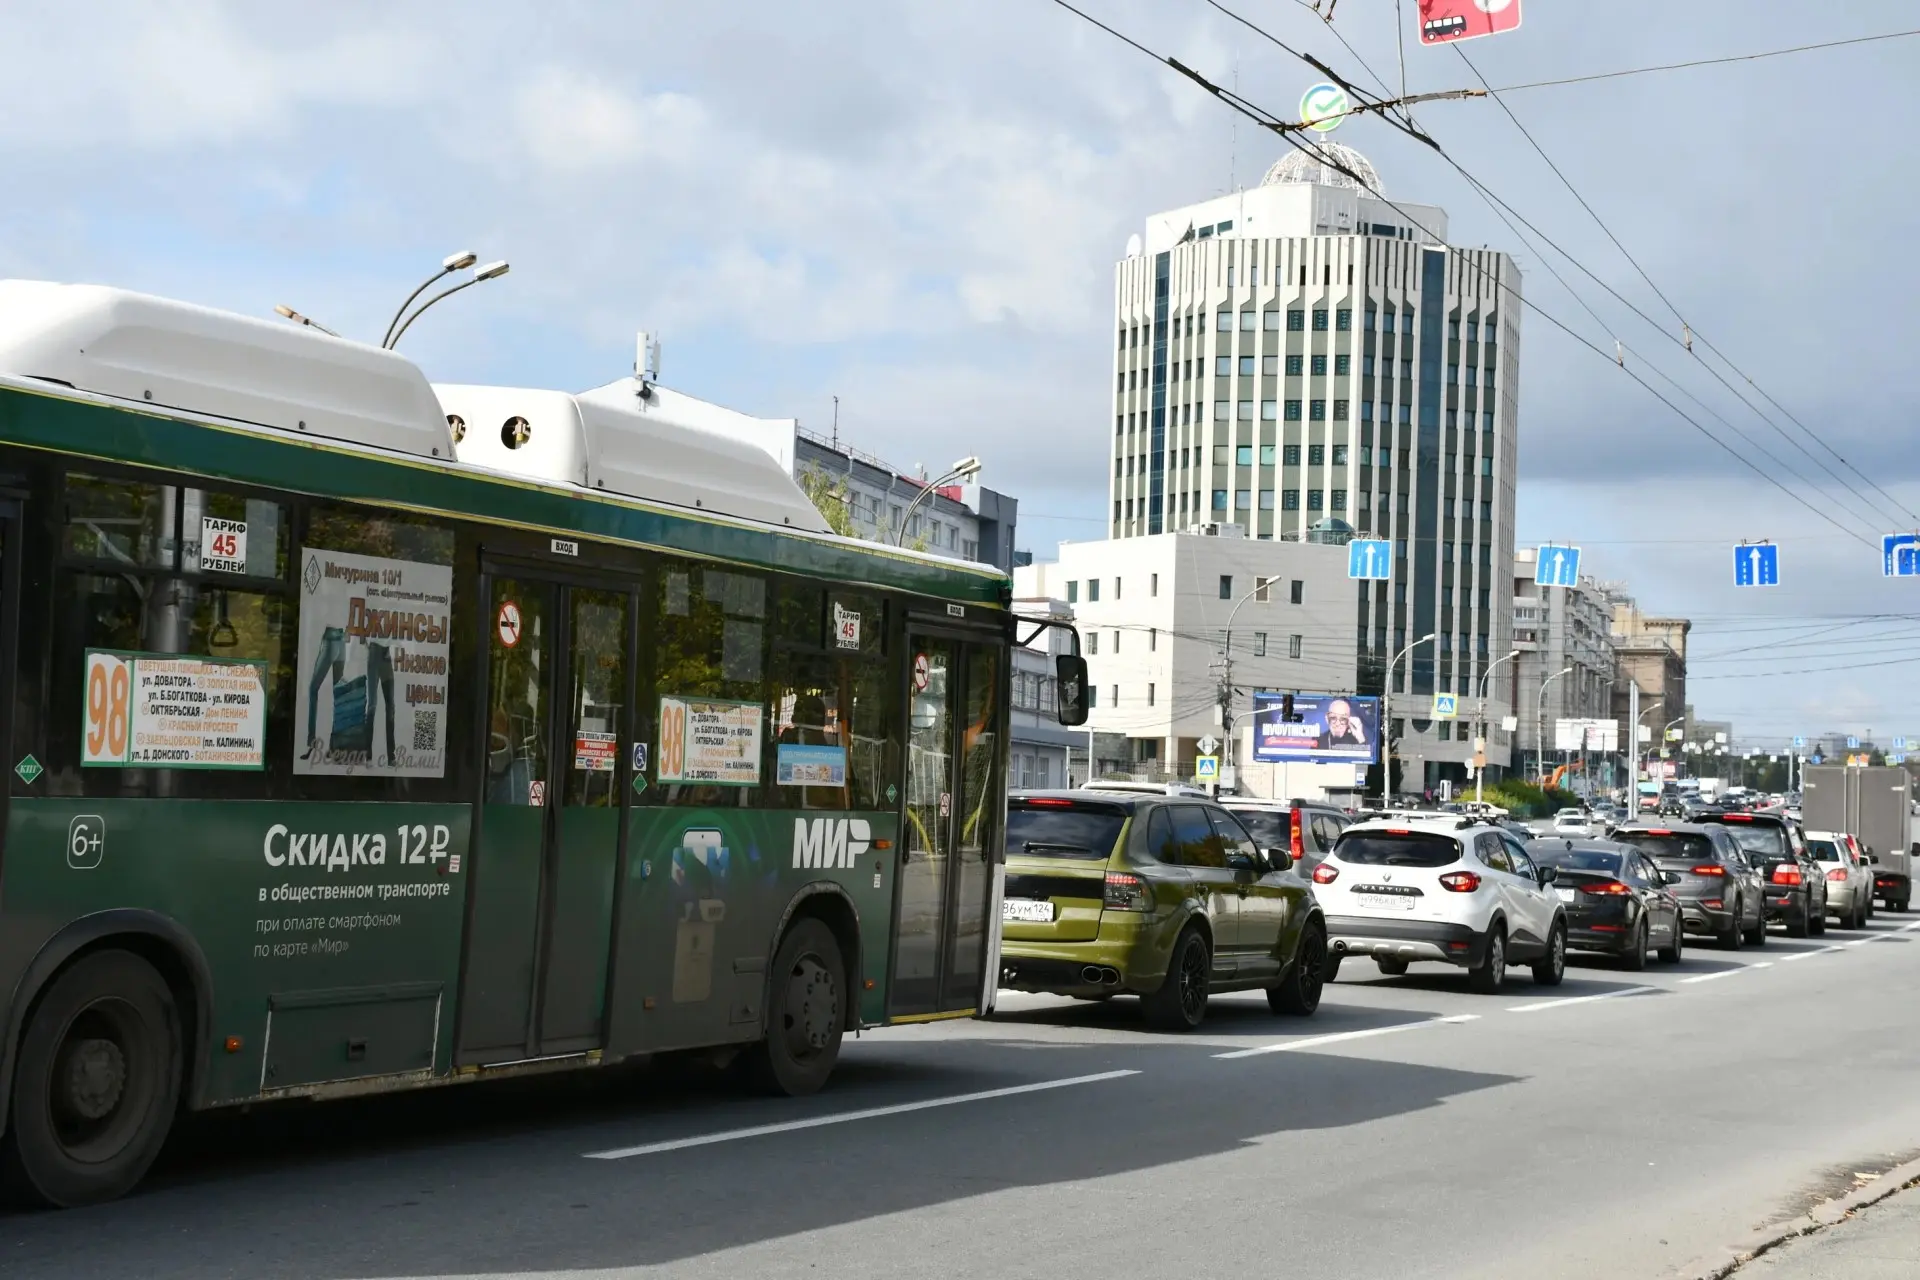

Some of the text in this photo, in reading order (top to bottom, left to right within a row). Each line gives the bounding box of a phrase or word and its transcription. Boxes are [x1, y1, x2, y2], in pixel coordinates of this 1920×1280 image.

[204, 518, 246, 534] ТАРИФ
[212, 533, 237, 556] 45
[555, 541, 574, 555] ВХОД
[202, 557, 246, 573] РУБЛЕЙ
[324, 561, 403, 587] Мичурина 10/1
[345, 597, 448, 645] Джинсы
[838, 611, 860, 621] ТАРИФ
[842, 621, 855, 638] 45
[394, 647, 447, 676] Низкие
[142, 676, 153, 688] ул.
[154, 675, 192, 688] ДОВАТОРА
[206, 678, 238, 690] ЗОЛОТАЯ
[148, 690, 251, 706] ул. Б.БОГАТКОВА ул. КИРОВА
[405, 683, 446, 708] цены
[87, 662, 130, 757] 98
[150, 704, 201, 717] ОКТЯБРЬСКАЯ
[220, 707, 249, 719] ЛЕНИНА
[216, 737, 255, 751] КАЛИНИНА)
[661, 704, 684, 776] 98
[131, 751, 142, 762] ул.
[143, 748, 151, 762] Д.
[152, 749, 190, 761] ДОНСКОГО
[310, 736, 373, 774] Всегда
[394, 744, 442, 772] Вами!
[72, 824, 101, 857] 6+
[263, 823, 387, 873] Скидка
[792, 817, 871, 869] МИР
[259, 882, 450, 903] в общественном транспорте
[256, 911, 401, 935] при оплате смартфоном
[254, 938, 350, 959] по карте «Мир»
